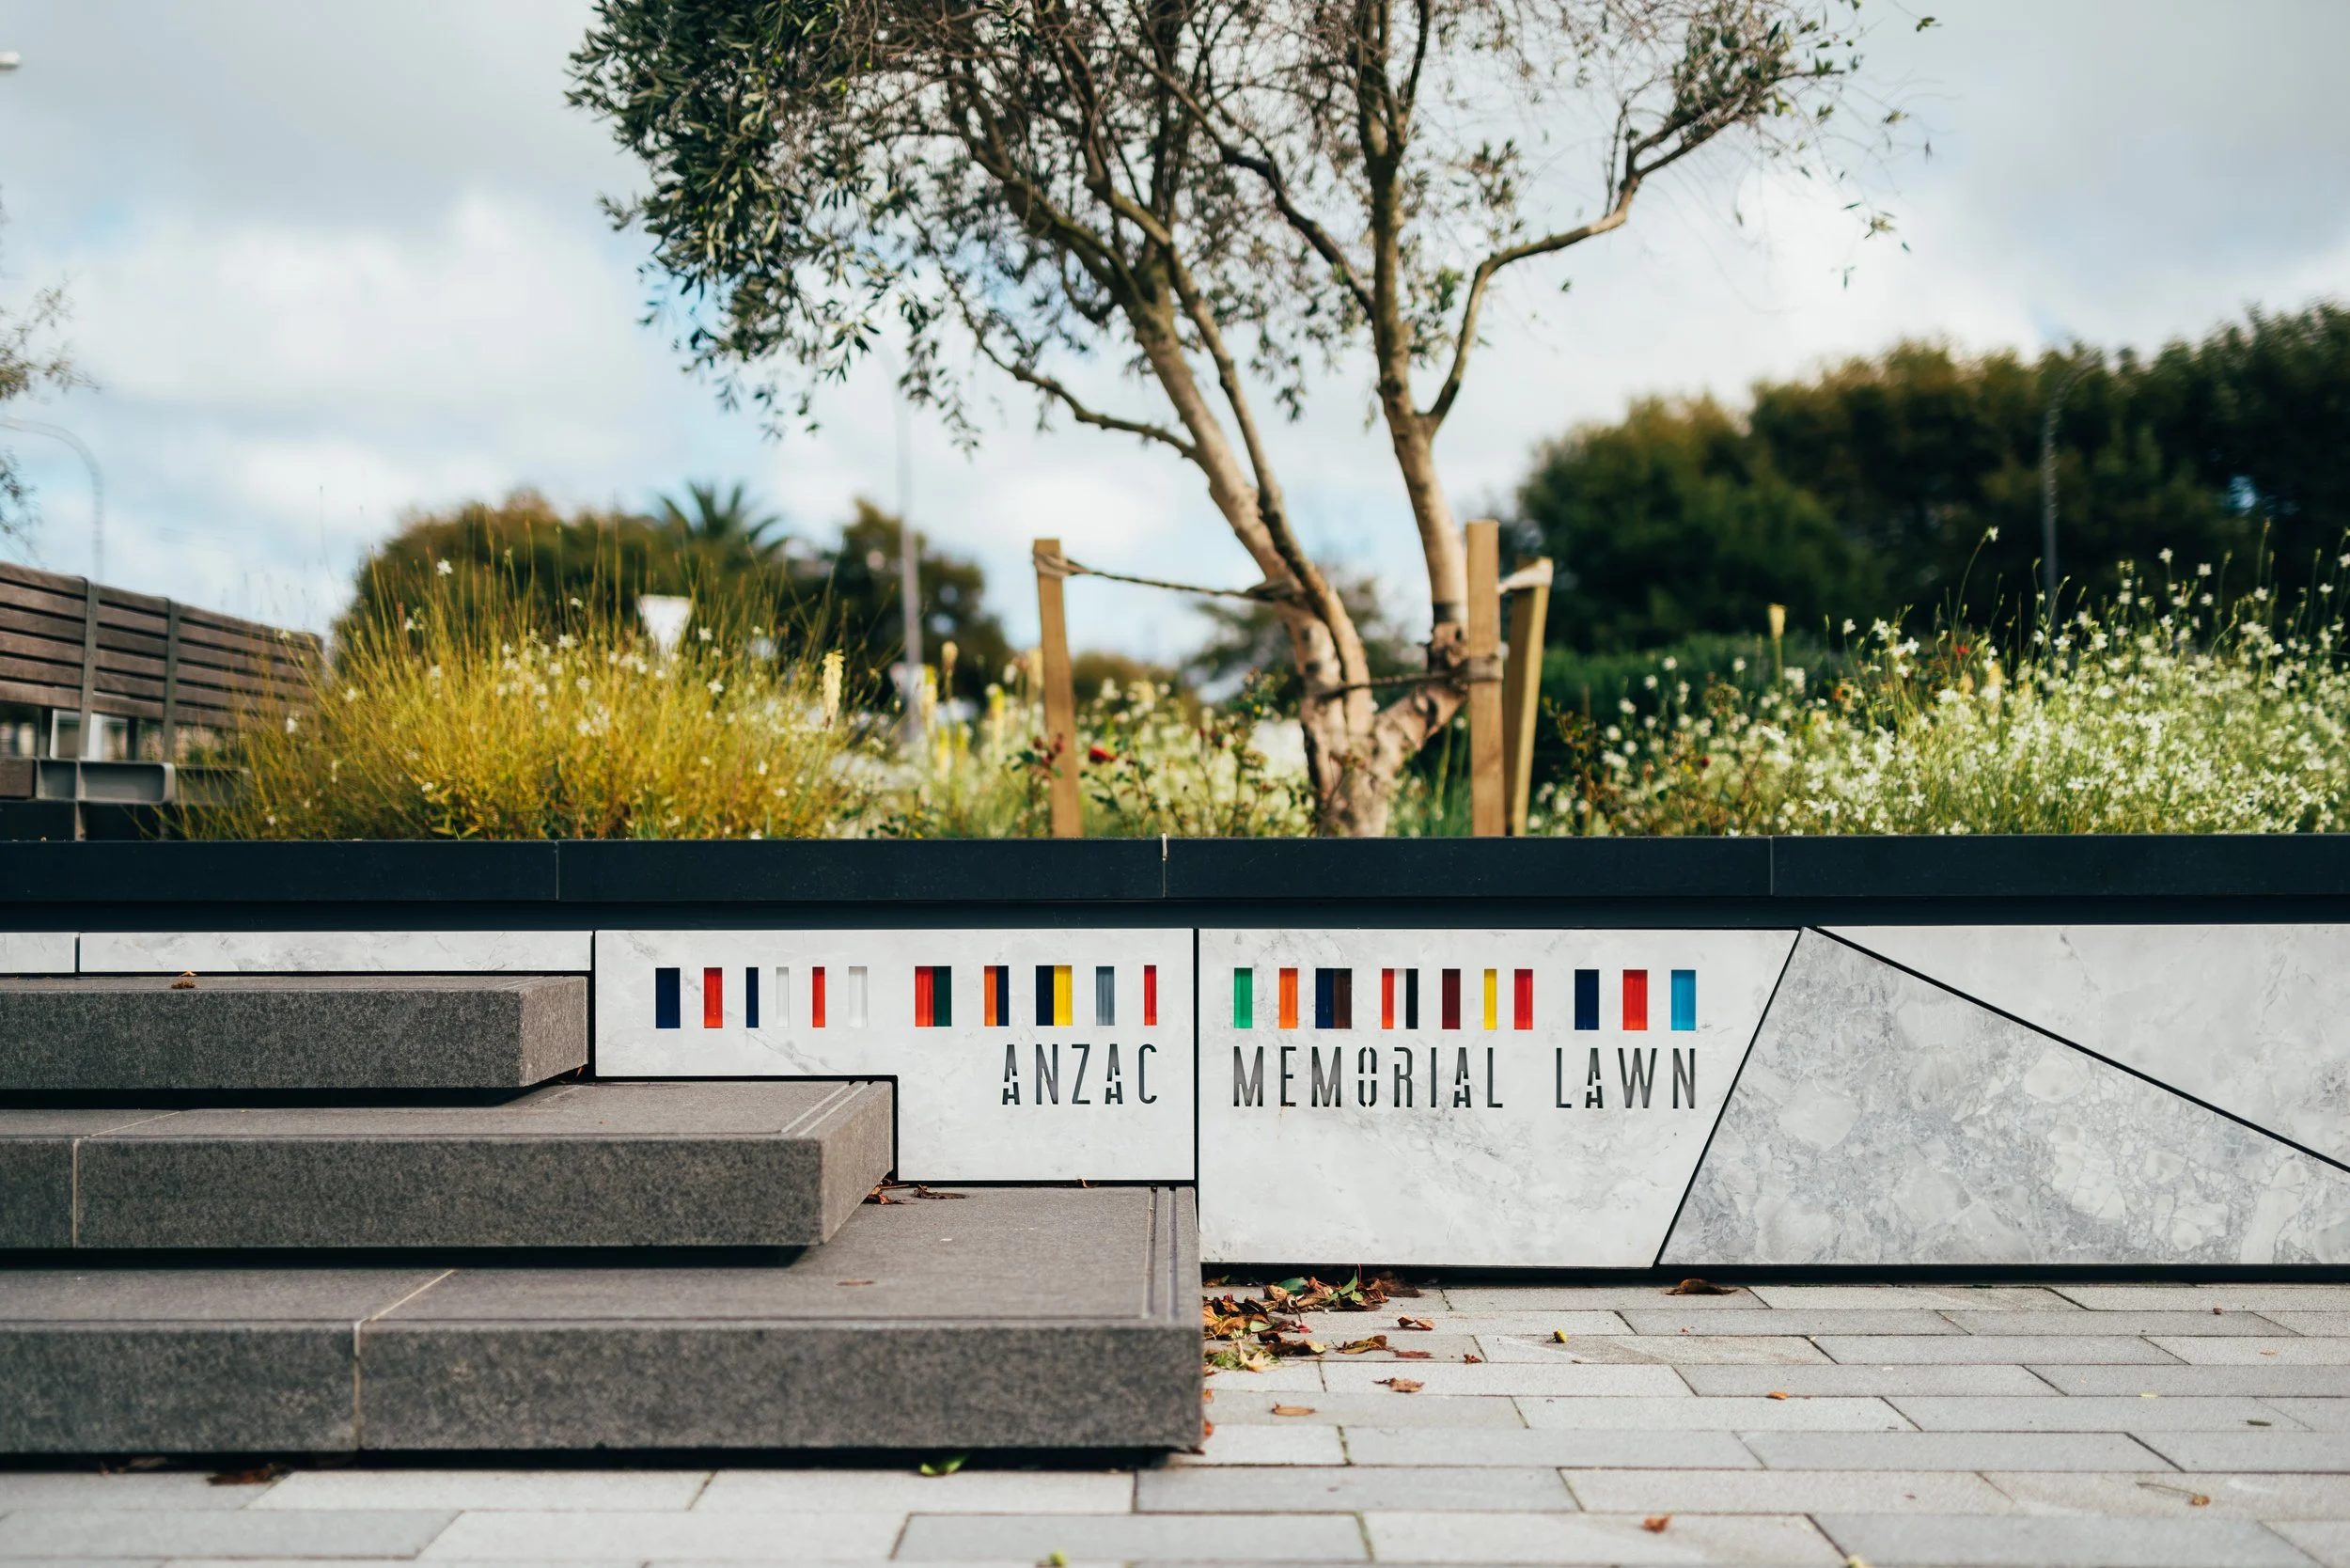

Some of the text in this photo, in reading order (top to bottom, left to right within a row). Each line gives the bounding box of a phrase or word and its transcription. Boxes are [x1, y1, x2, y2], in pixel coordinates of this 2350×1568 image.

[1002, 1043, 1697, 1109] ANZAC MEMORIAL LAWN
